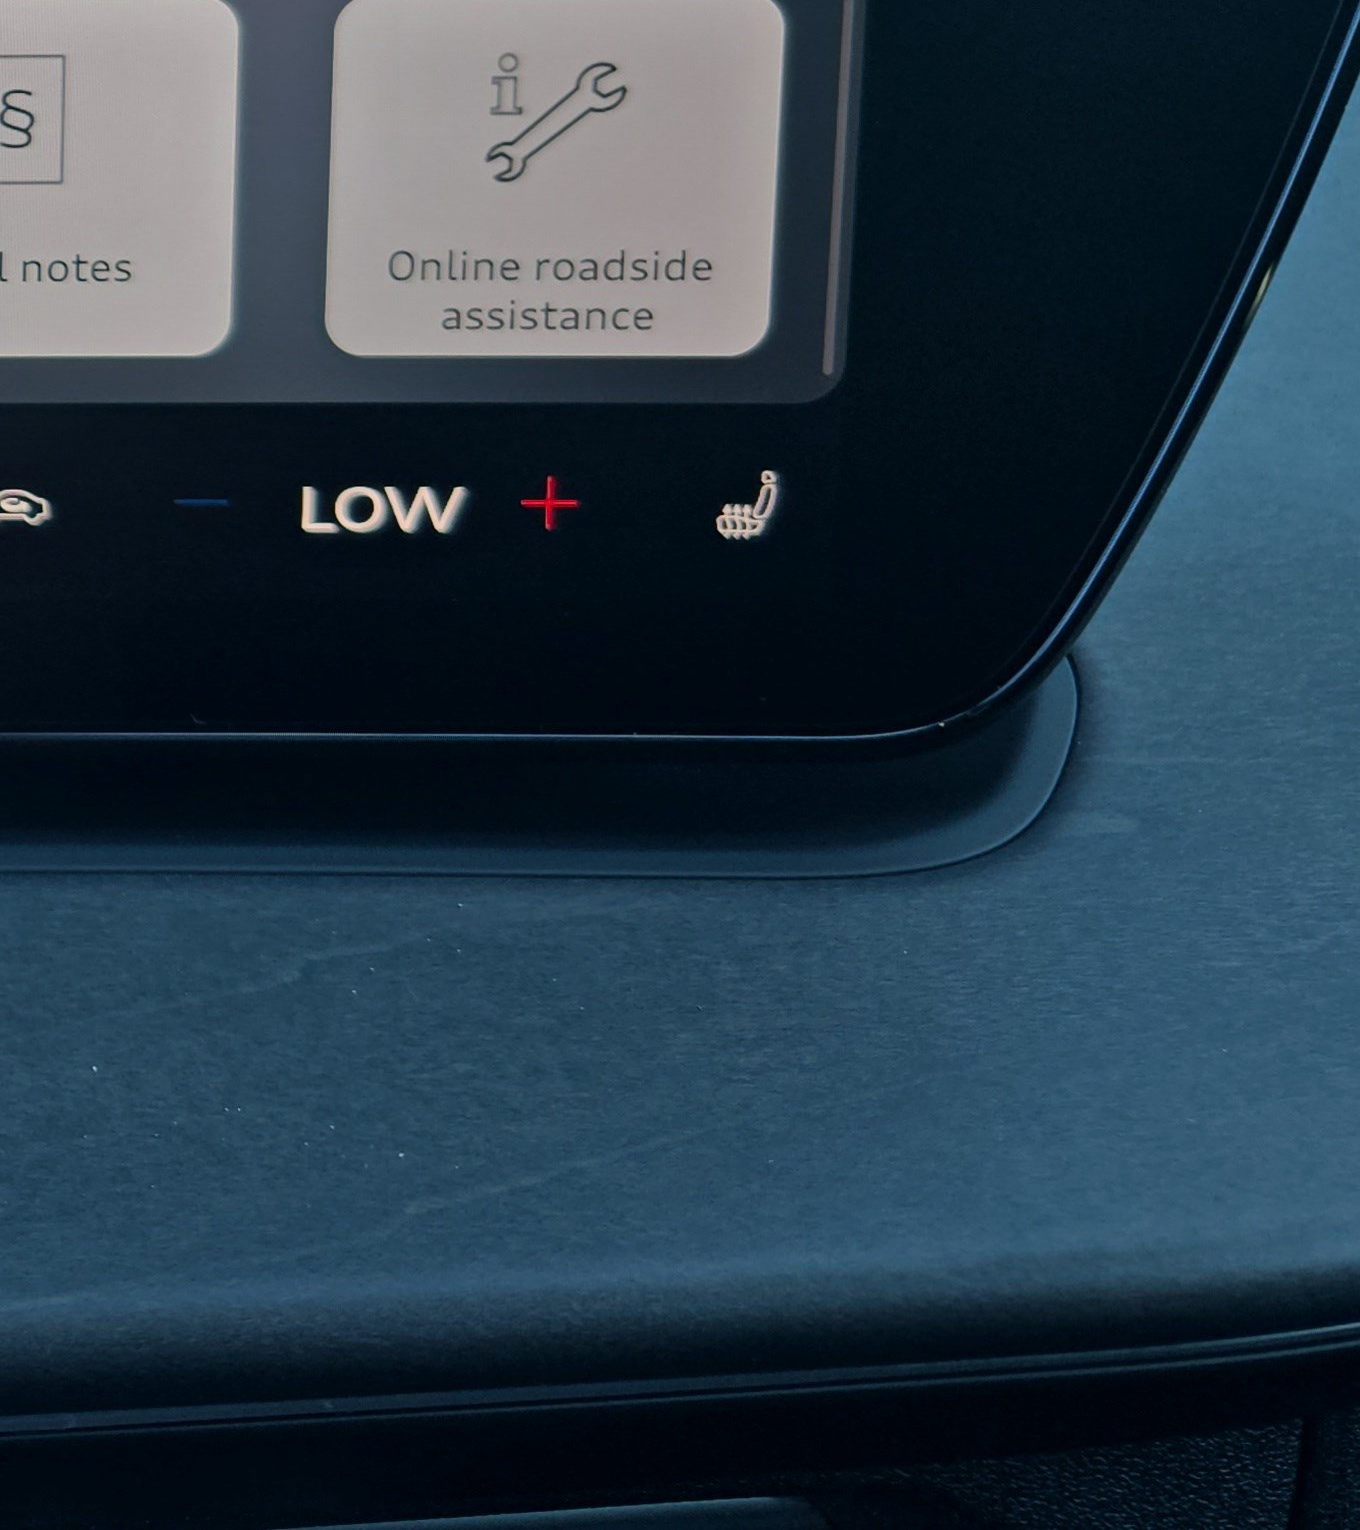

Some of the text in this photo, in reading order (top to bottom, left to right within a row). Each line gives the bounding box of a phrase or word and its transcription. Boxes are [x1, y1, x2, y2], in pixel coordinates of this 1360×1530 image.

[22, 254, 132, 282] notes
[389, 250, 713, 281] Online roadside
[442, 302, 654, 331] assistance
[301, 486, 467, 533] LOW
